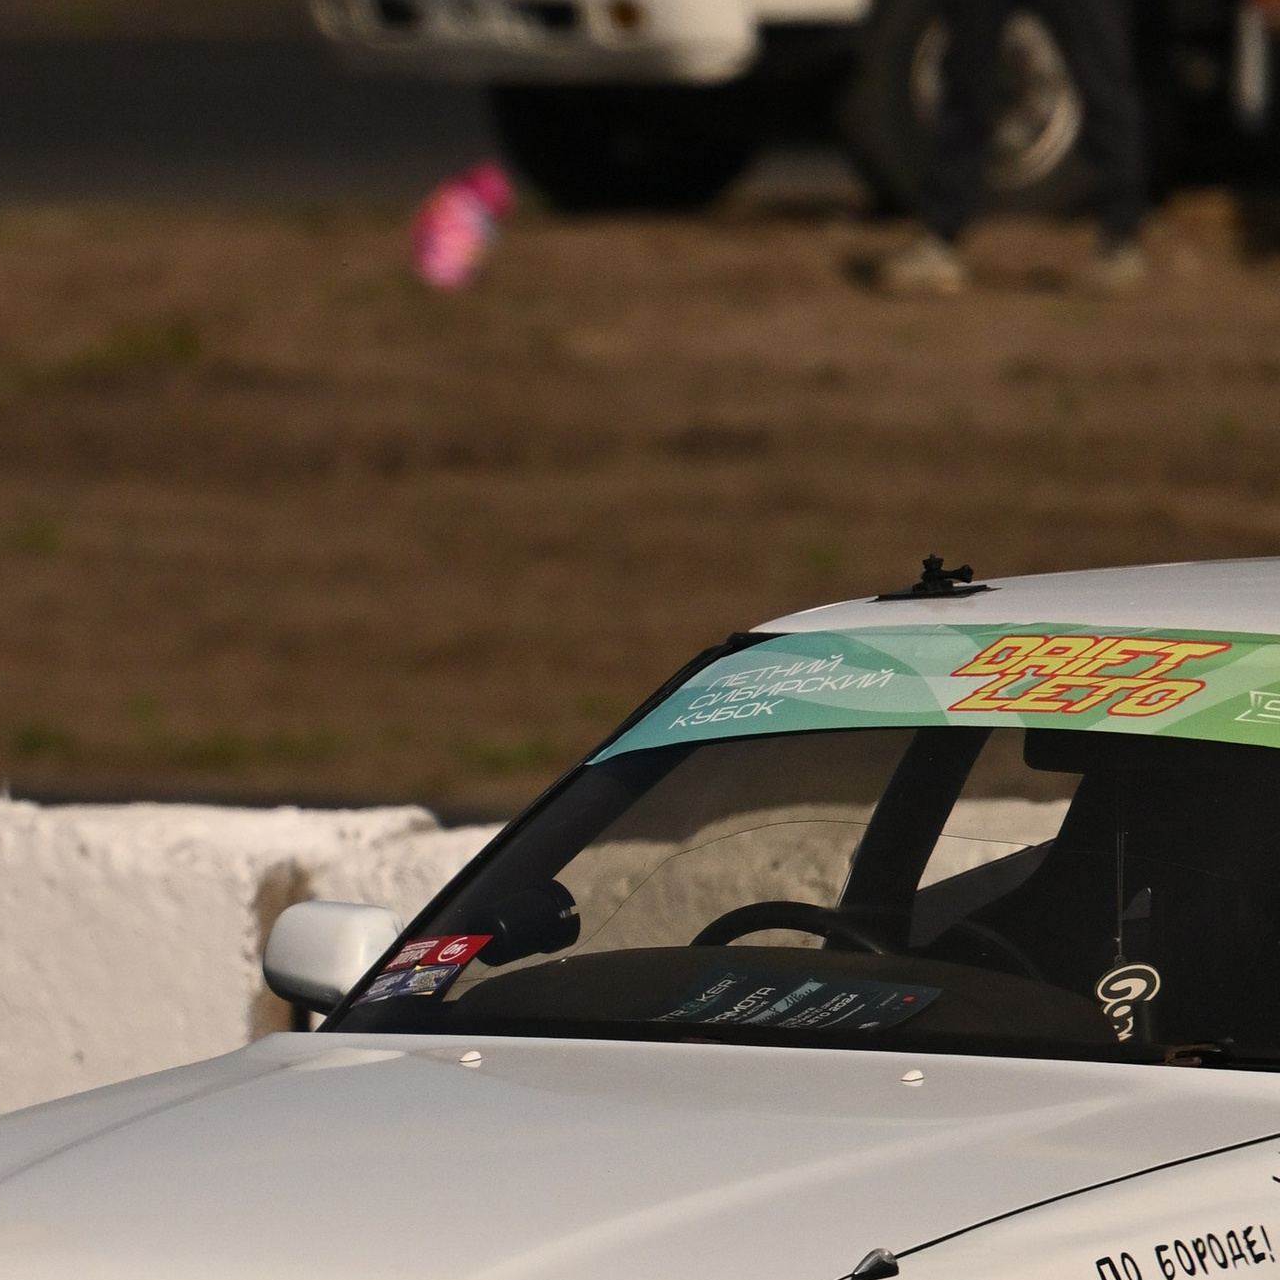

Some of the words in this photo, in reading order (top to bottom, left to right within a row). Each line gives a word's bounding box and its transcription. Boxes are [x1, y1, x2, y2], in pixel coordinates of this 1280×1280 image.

[706, 654, 844, 691] ЛЕТНИЙ
[949, 635, 1233, 679] DRIFT
[688, 668, 894, 710] СИБИРСКИЙ
[947, 672, 1206, 717] LETO
[668, 699, 784, 730] КУБОК
[699, 987, 776, 1023] РАМОТА
